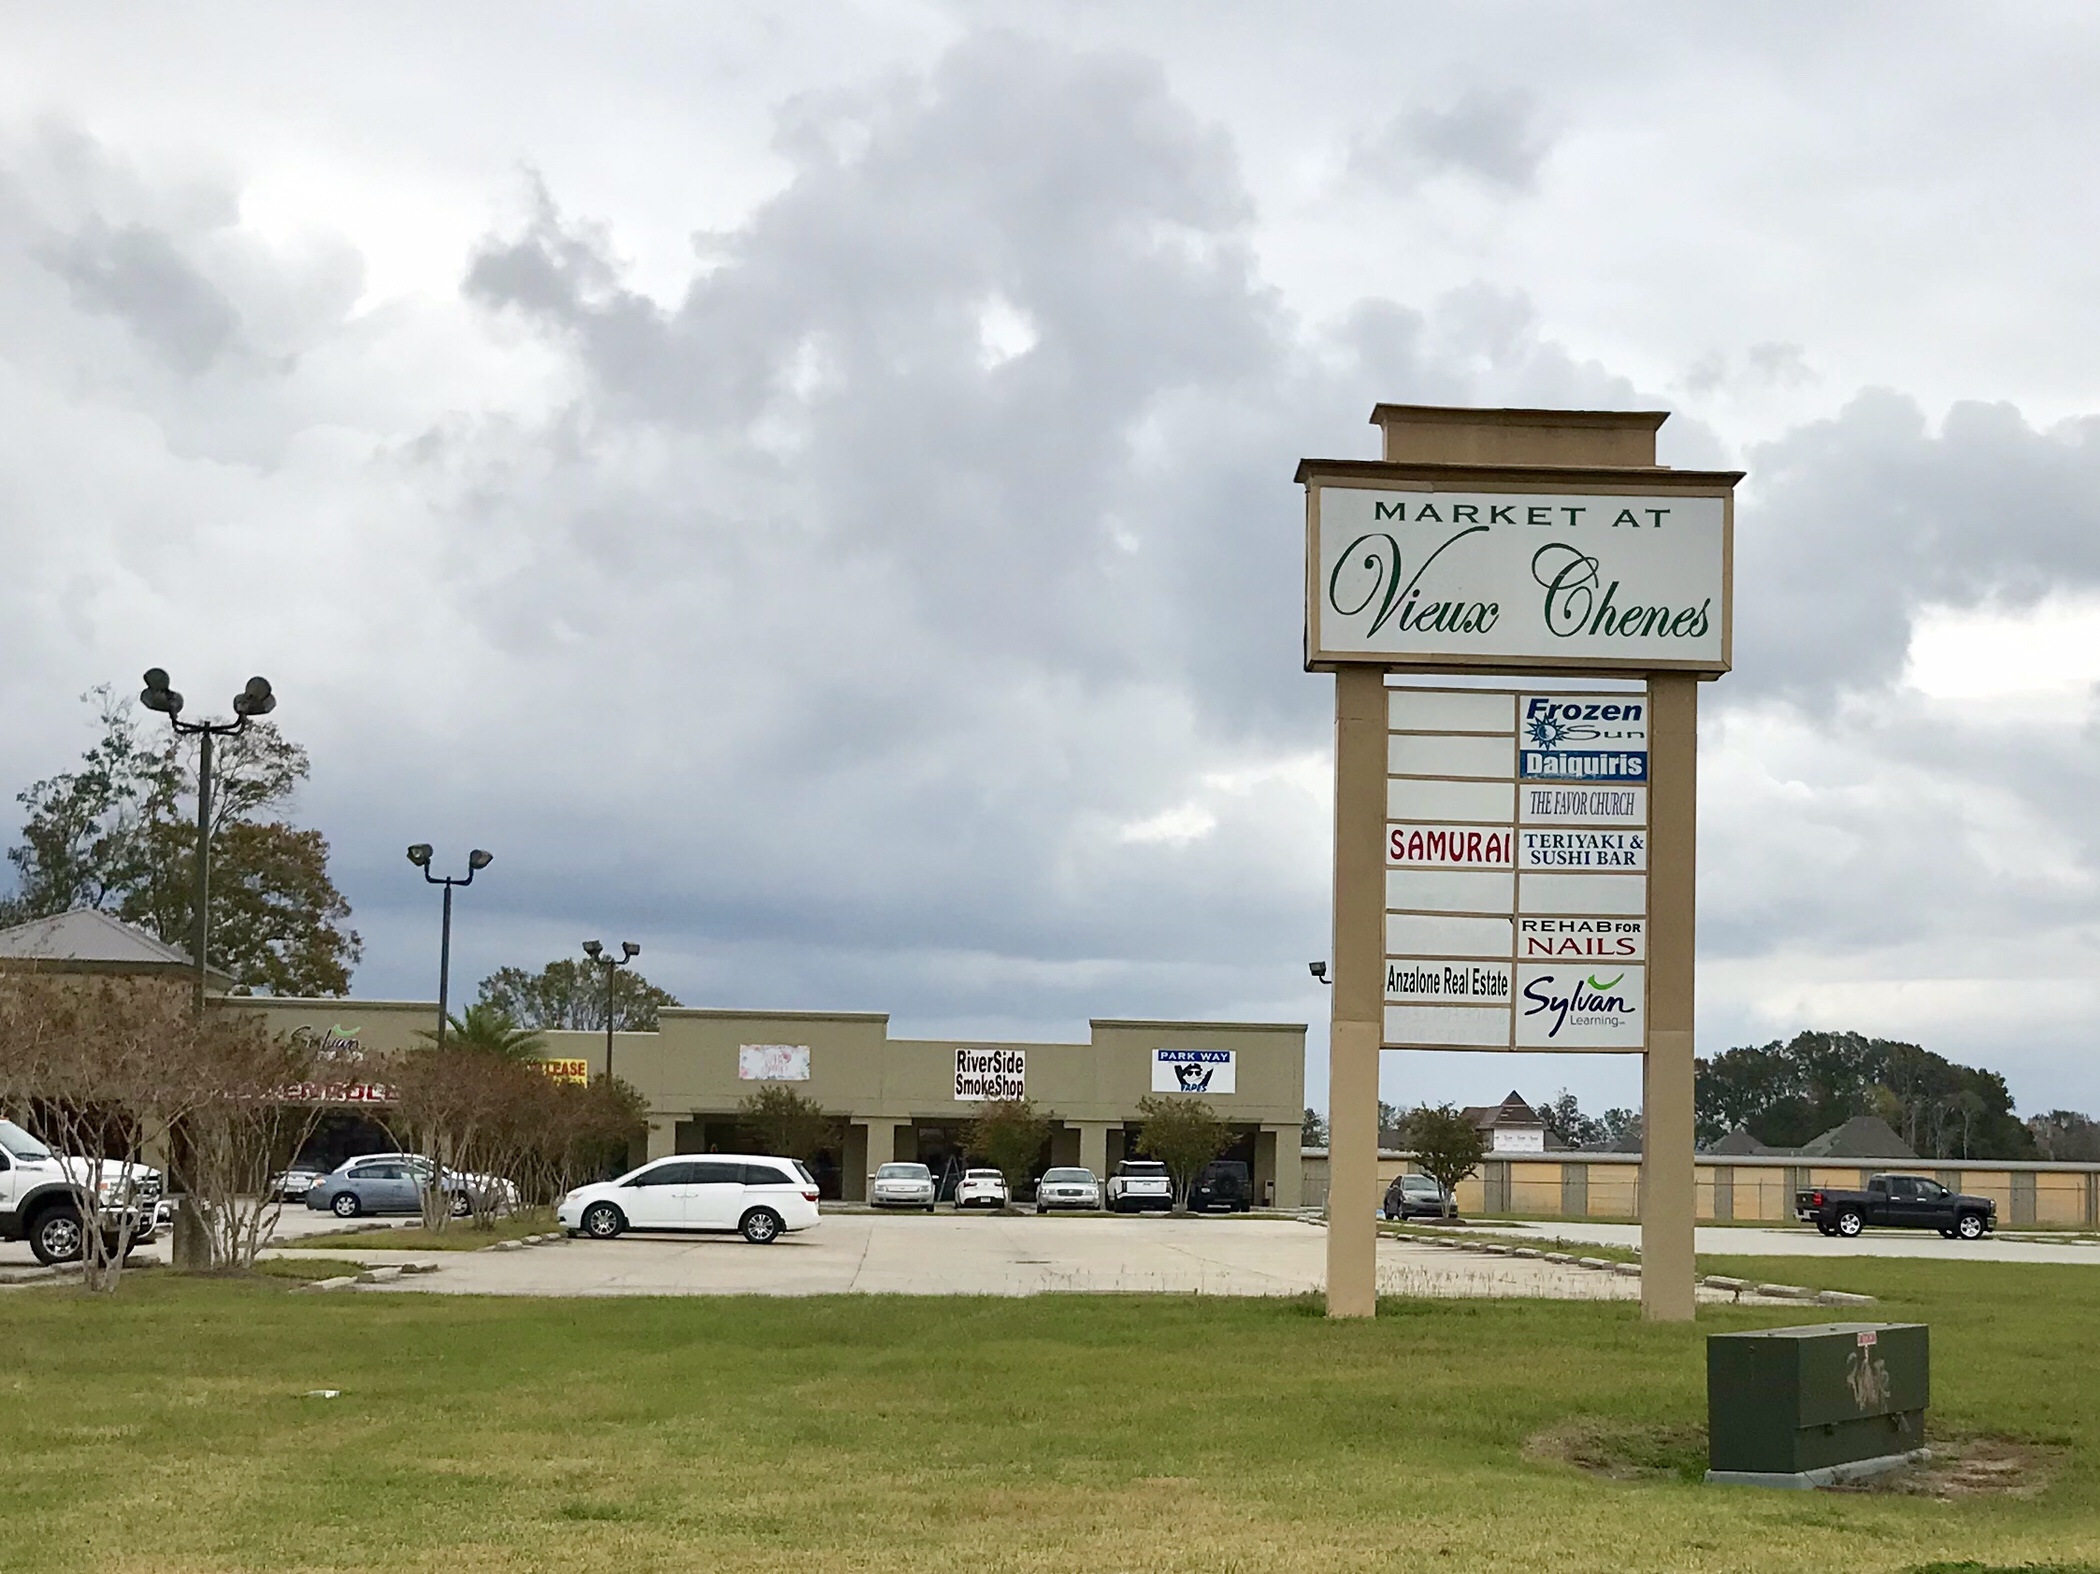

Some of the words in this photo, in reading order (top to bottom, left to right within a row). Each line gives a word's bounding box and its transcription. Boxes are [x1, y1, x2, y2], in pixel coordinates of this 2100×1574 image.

[1374, 501, 1587, 527] MARKET
[1611, 508, 1671, 528] AT
[1329, 525, 1499, 639] Vieux
[1531, 542, 1710, 638] Chenes
[1526, 698, 1643, 721] Frozen
[1563, 724, 1645, 741] Sun
[1526, 752, 1643, 776] Daiquiris
[1530, 790, 1553, 815] THE
[1554, 791, 1589, 816] FAVOR
[1590, 792, 1635, 816] CHURCH
[1390, 829, 1511, 862] SAMURAI
[1523, 833, 1625, 849] TERIYAKI
[1629, 835, 1644, 850] &
[1530, 849, 1592, 865] SUSHI
[1596, 850, 1637, 866] BAR
[1521, 920, 1612, 933] REHAB
[1615, 923, 1641, 933] FOR
[1527, 937, 1636, 955] NAILS
[1386, 964, 1440, 994] Anzalone
[1443, 966, 1469, 995] Real
[1472, 968, 1508, 996] Estate
[1523, 975, 1636, 1038] Sylvan
[1570, 1014, 1619, 1027] Learning
[956, 1049, 1024, 1074] RiverSide
[1160, 1051, 1195, 1060] PARK
[1200, 1052, 1228, 1061] WAY
[546, 1061, 586, 1076] LEASE
[955, 1073, 1024, 1099] SmokeShop
